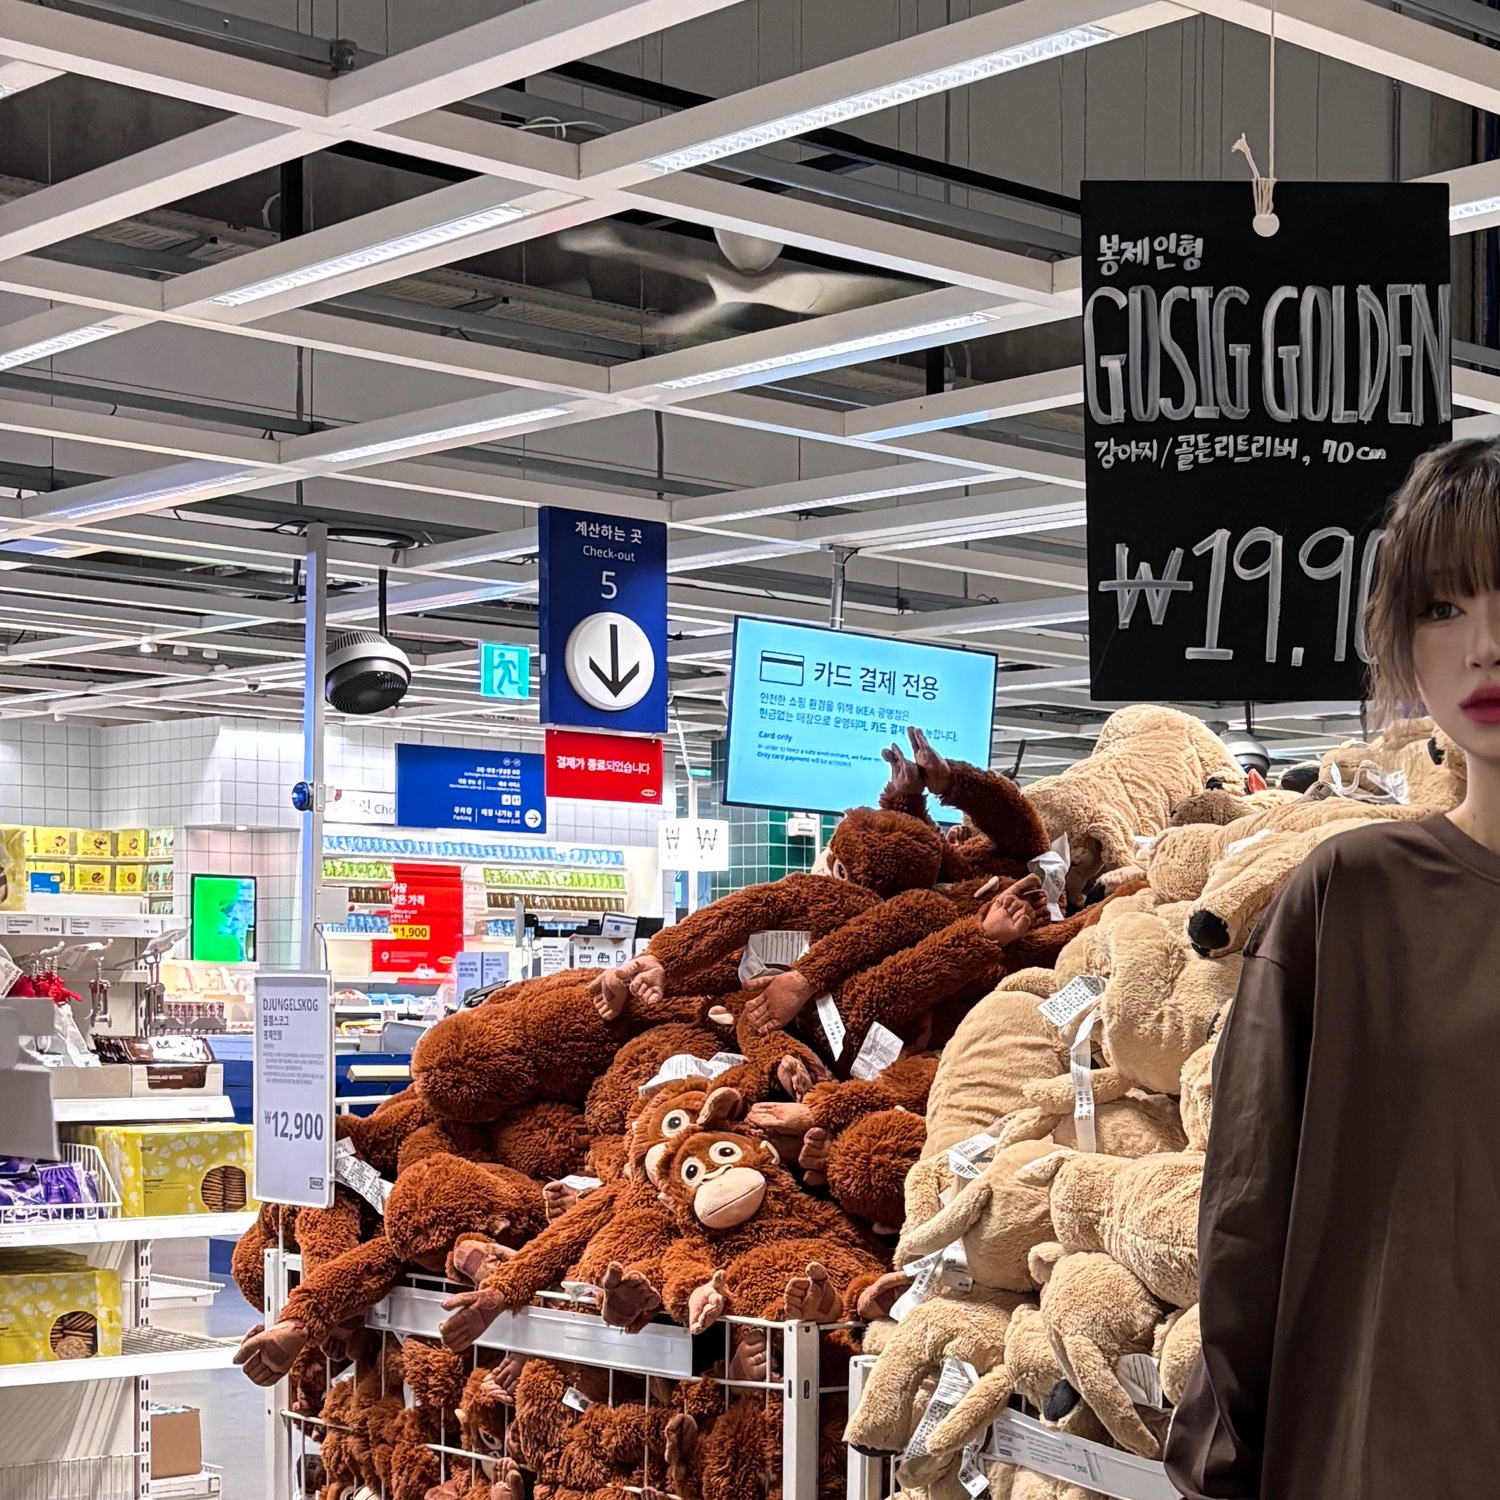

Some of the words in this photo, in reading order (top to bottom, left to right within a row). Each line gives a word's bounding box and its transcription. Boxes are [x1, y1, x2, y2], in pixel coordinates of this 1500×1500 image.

[1084, 284, 1250, 424] GOSIG
[1262, 284, 1451, 425] GOLDEN
[575, 521, 626, 542] 계산하는
[630, 528, 642, 544] 곳
[582, 545, 635, 562] Check-out
[600, 570, 617, 600] 5
[814, 662, 852, 688] 카드
[859, 667, 896, 696] 결제
[902, 672, 939, 701] 전용
[760, 692, 786, 706] 안전한
[856, 706, 875, 716] IKEA
[759, 730, 776, 739] Card
[777, 734, 792, 743] only
[870, 722, 887, 732] 카드
[556, 756, 585, 771] 결제가
[587, 758, 650, 775] 종료되었습니다
[263, 998, 318, 1012] DJUNGELSKOG
[264, 1110, 323, 1141] ₩12,900
